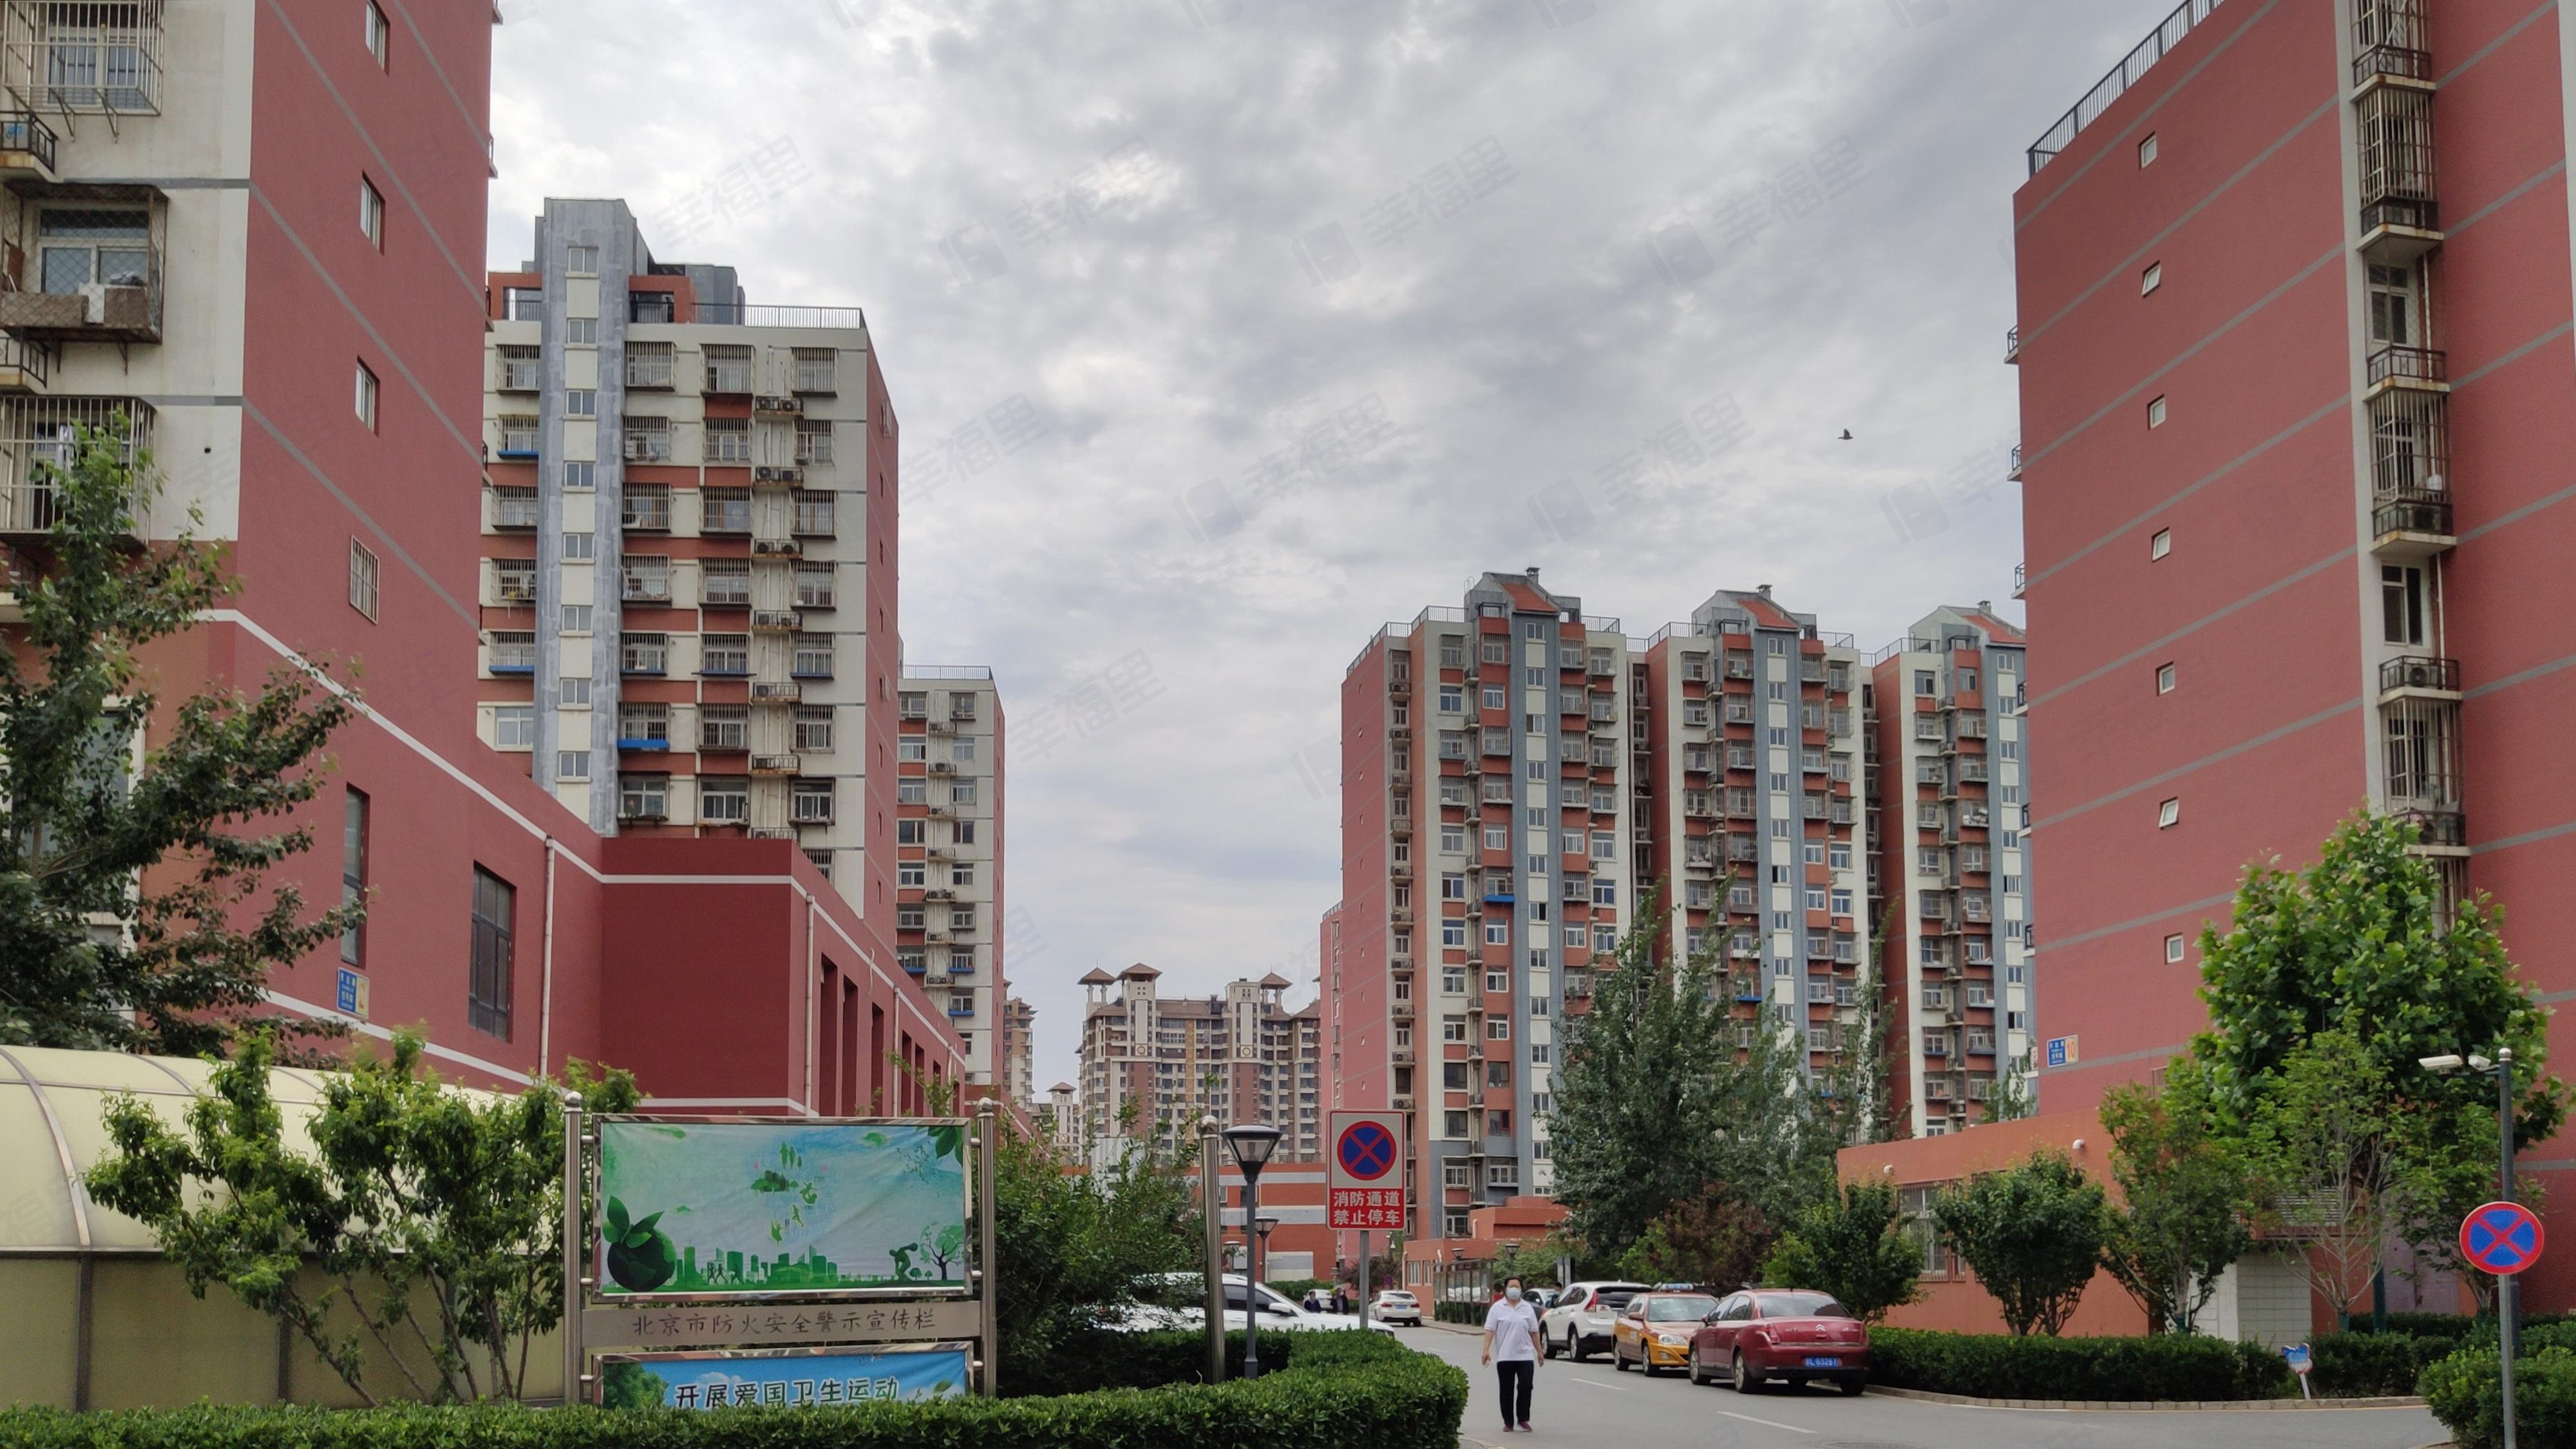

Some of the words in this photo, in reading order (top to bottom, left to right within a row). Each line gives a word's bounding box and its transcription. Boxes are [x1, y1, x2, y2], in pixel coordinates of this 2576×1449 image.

[1333, 1191, 1401, 1207] 消防通道
[1333, 1209, 1401, 1226] 禁止停车
[632, 1308, 936, 1336] 北京市防火安全警示宣传栏
[675, 1377, 899, 1408] 开展爱国卫生运动
